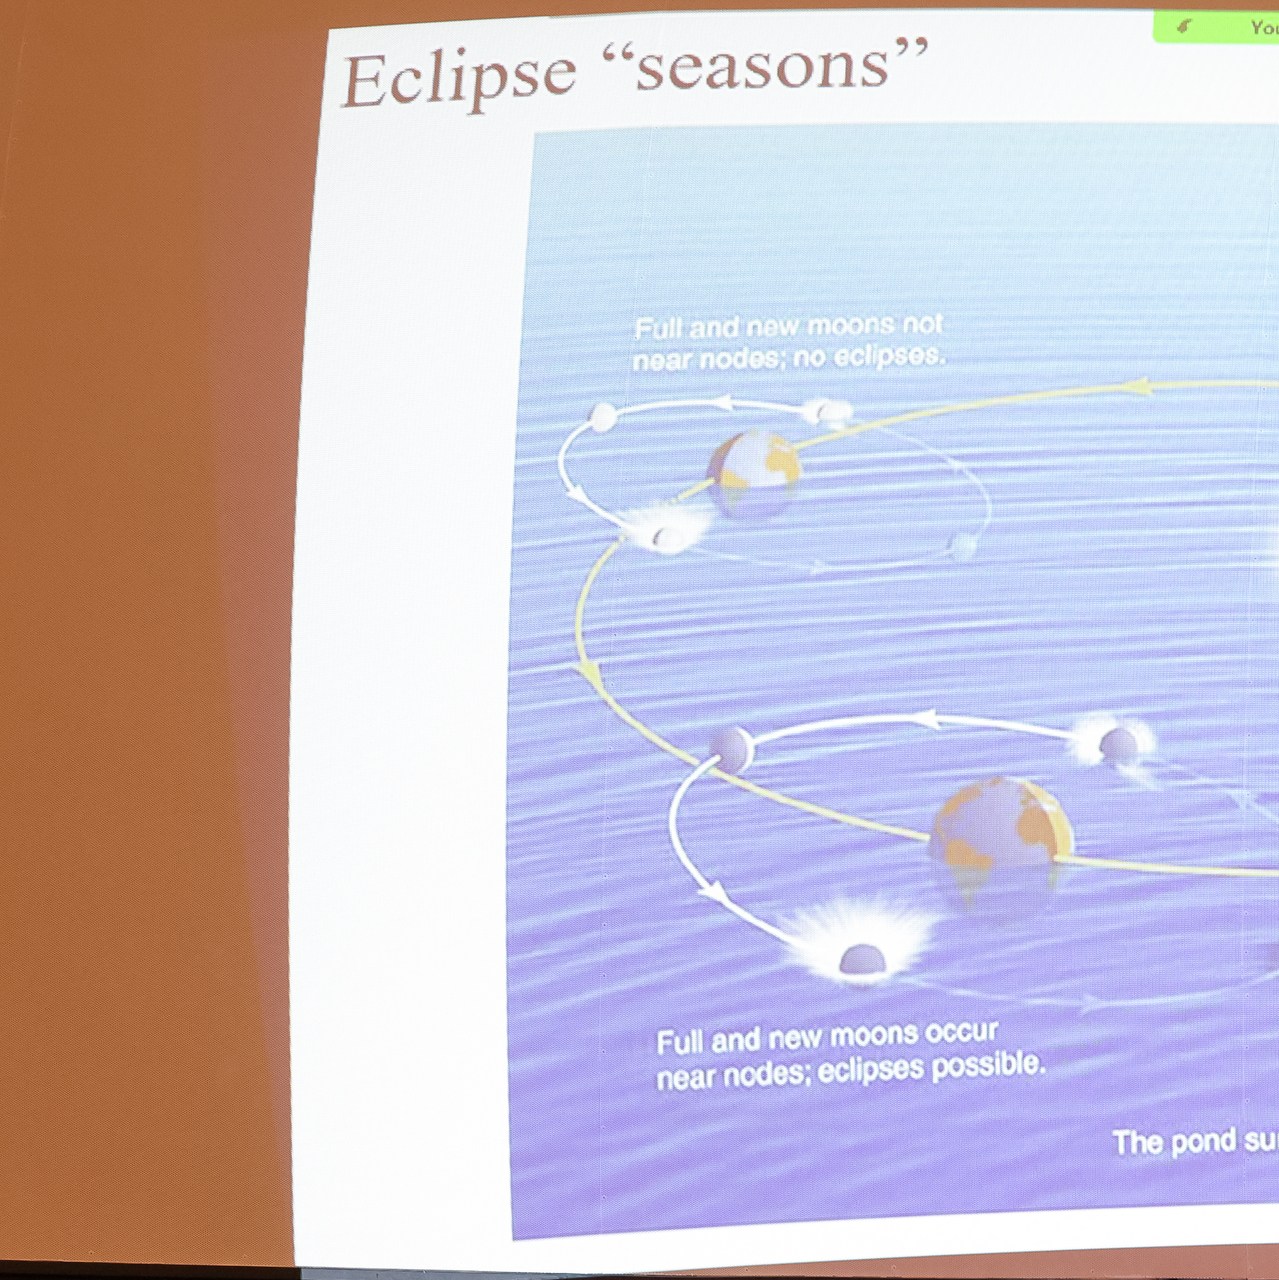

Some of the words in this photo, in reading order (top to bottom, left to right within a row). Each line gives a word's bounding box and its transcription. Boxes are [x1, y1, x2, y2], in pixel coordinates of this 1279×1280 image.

[340, 46, 576, 117] Eclipse
[602, 36, 929, 92] “seasons”
[635, 316, 682, 340] Full
[690, 316, 739, 338] and
[747, 317, 800, 337] new
[808, 314, 895, 335] moons
[903, 312, 944, 334] not
[633, 351, 693, 372] near
[700, 347, 787, 371] nodes;
[794, 348, 826, 368] no
[834, 343, 947, 371] eclipses.
[656, 1029, 703, 1056] Full
[711, 1026, 761, 1053] and
[769, 1028, 823, 1050] new
[830, 1023, 920, 1049] moons
[924, 1020, 1000, 1044] occur
[657, 1067, 717, 1091] near
[723, 1060, 813, 1088] nodes;
[817, 1056, 925, 1087] eclipses
[931, 1050, 1047, 1084] possible.
[1112, 1129, 1164, 1155] The
[1172, 1127, 1236, 1159] pond
